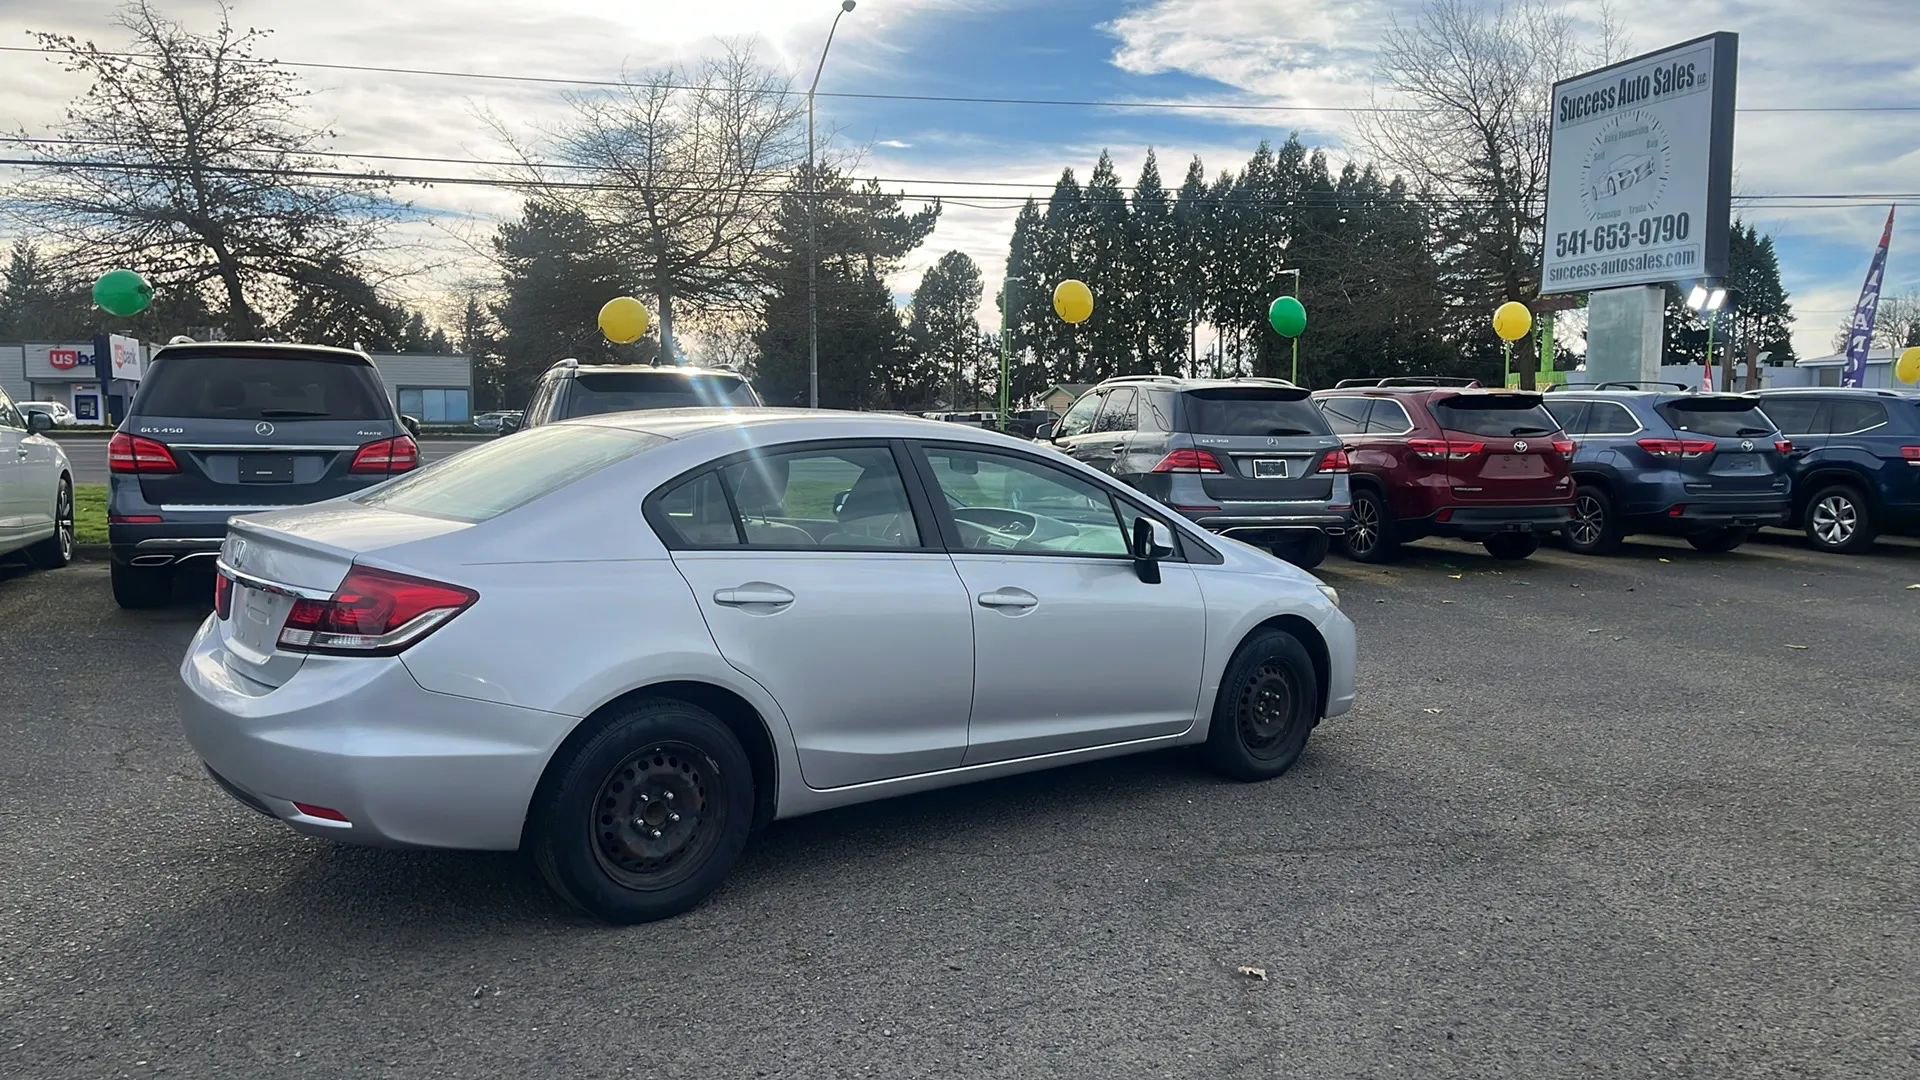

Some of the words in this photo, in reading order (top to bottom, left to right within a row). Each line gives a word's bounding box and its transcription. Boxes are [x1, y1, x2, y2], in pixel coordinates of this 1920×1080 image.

[1560, 86, 1616, 123] Success
[1617, 75, 1650, 107] Auto
[1653, 62, 1695, 96] Sales
[1556, 211, 1690, 258] 541-653-9790
[1549, 250, 1695, 282] success-autosales.com
[161, 426, 184, 434] 450
